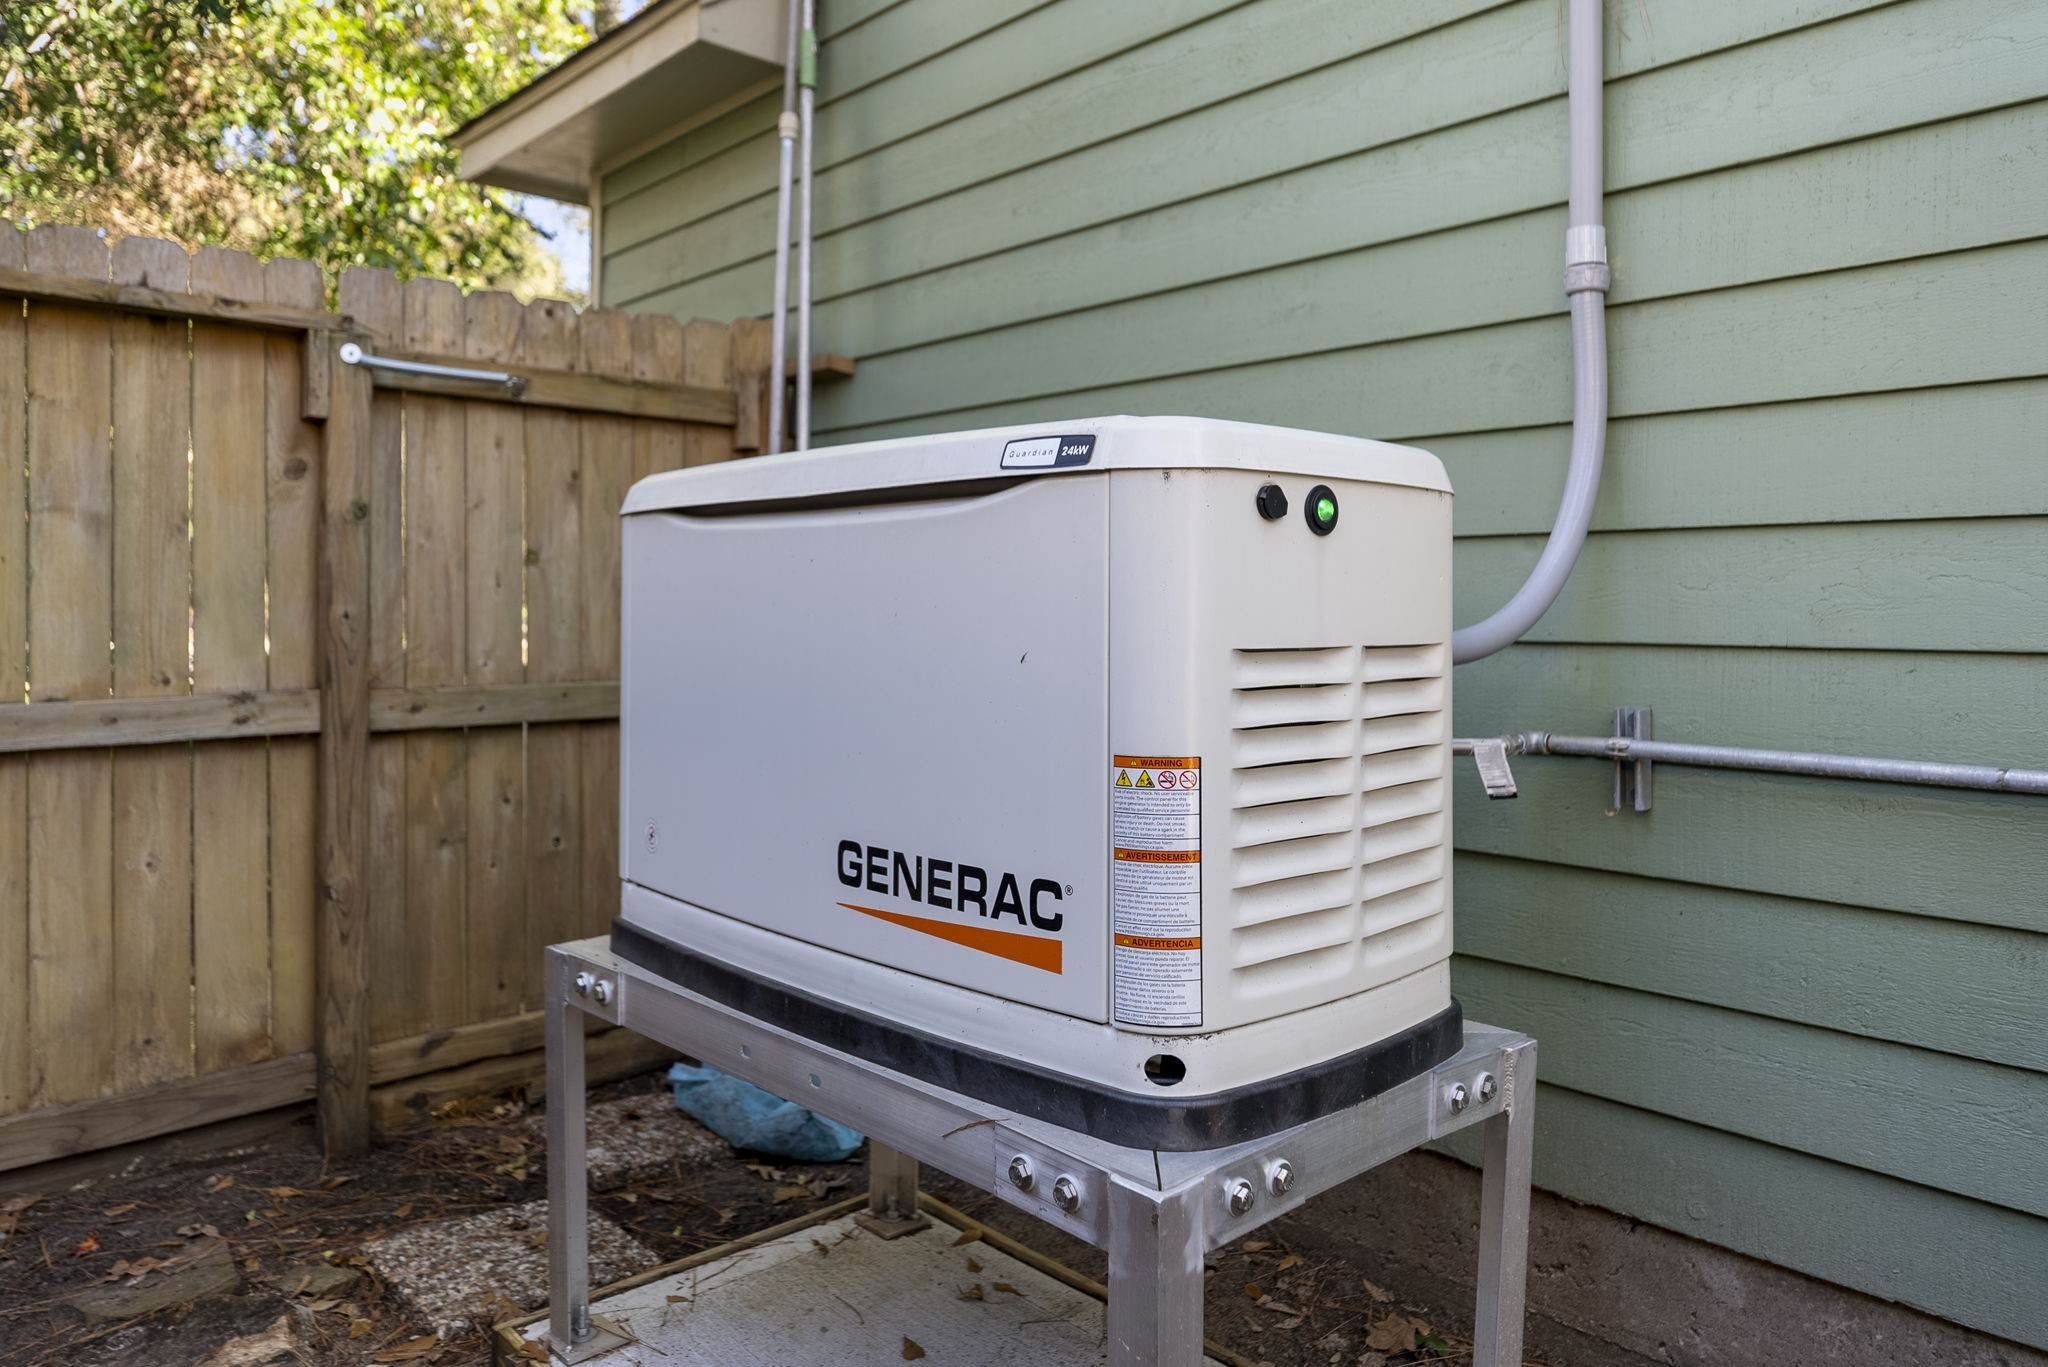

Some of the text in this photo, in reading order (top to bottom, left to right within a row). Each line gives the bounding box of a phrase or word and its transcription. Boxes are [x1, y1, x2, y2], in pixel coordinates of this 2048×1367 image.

[1008, 444, 1090, 458] Guardian 24kW
[1140, 759, 1183, 767] WARNING
[1126, 852, 1196, 861] AVERTISSEMENT
[837, 839, 1064, 932] GENERAC
[1132, 939, 1193, 947] ADVERTENCIA
